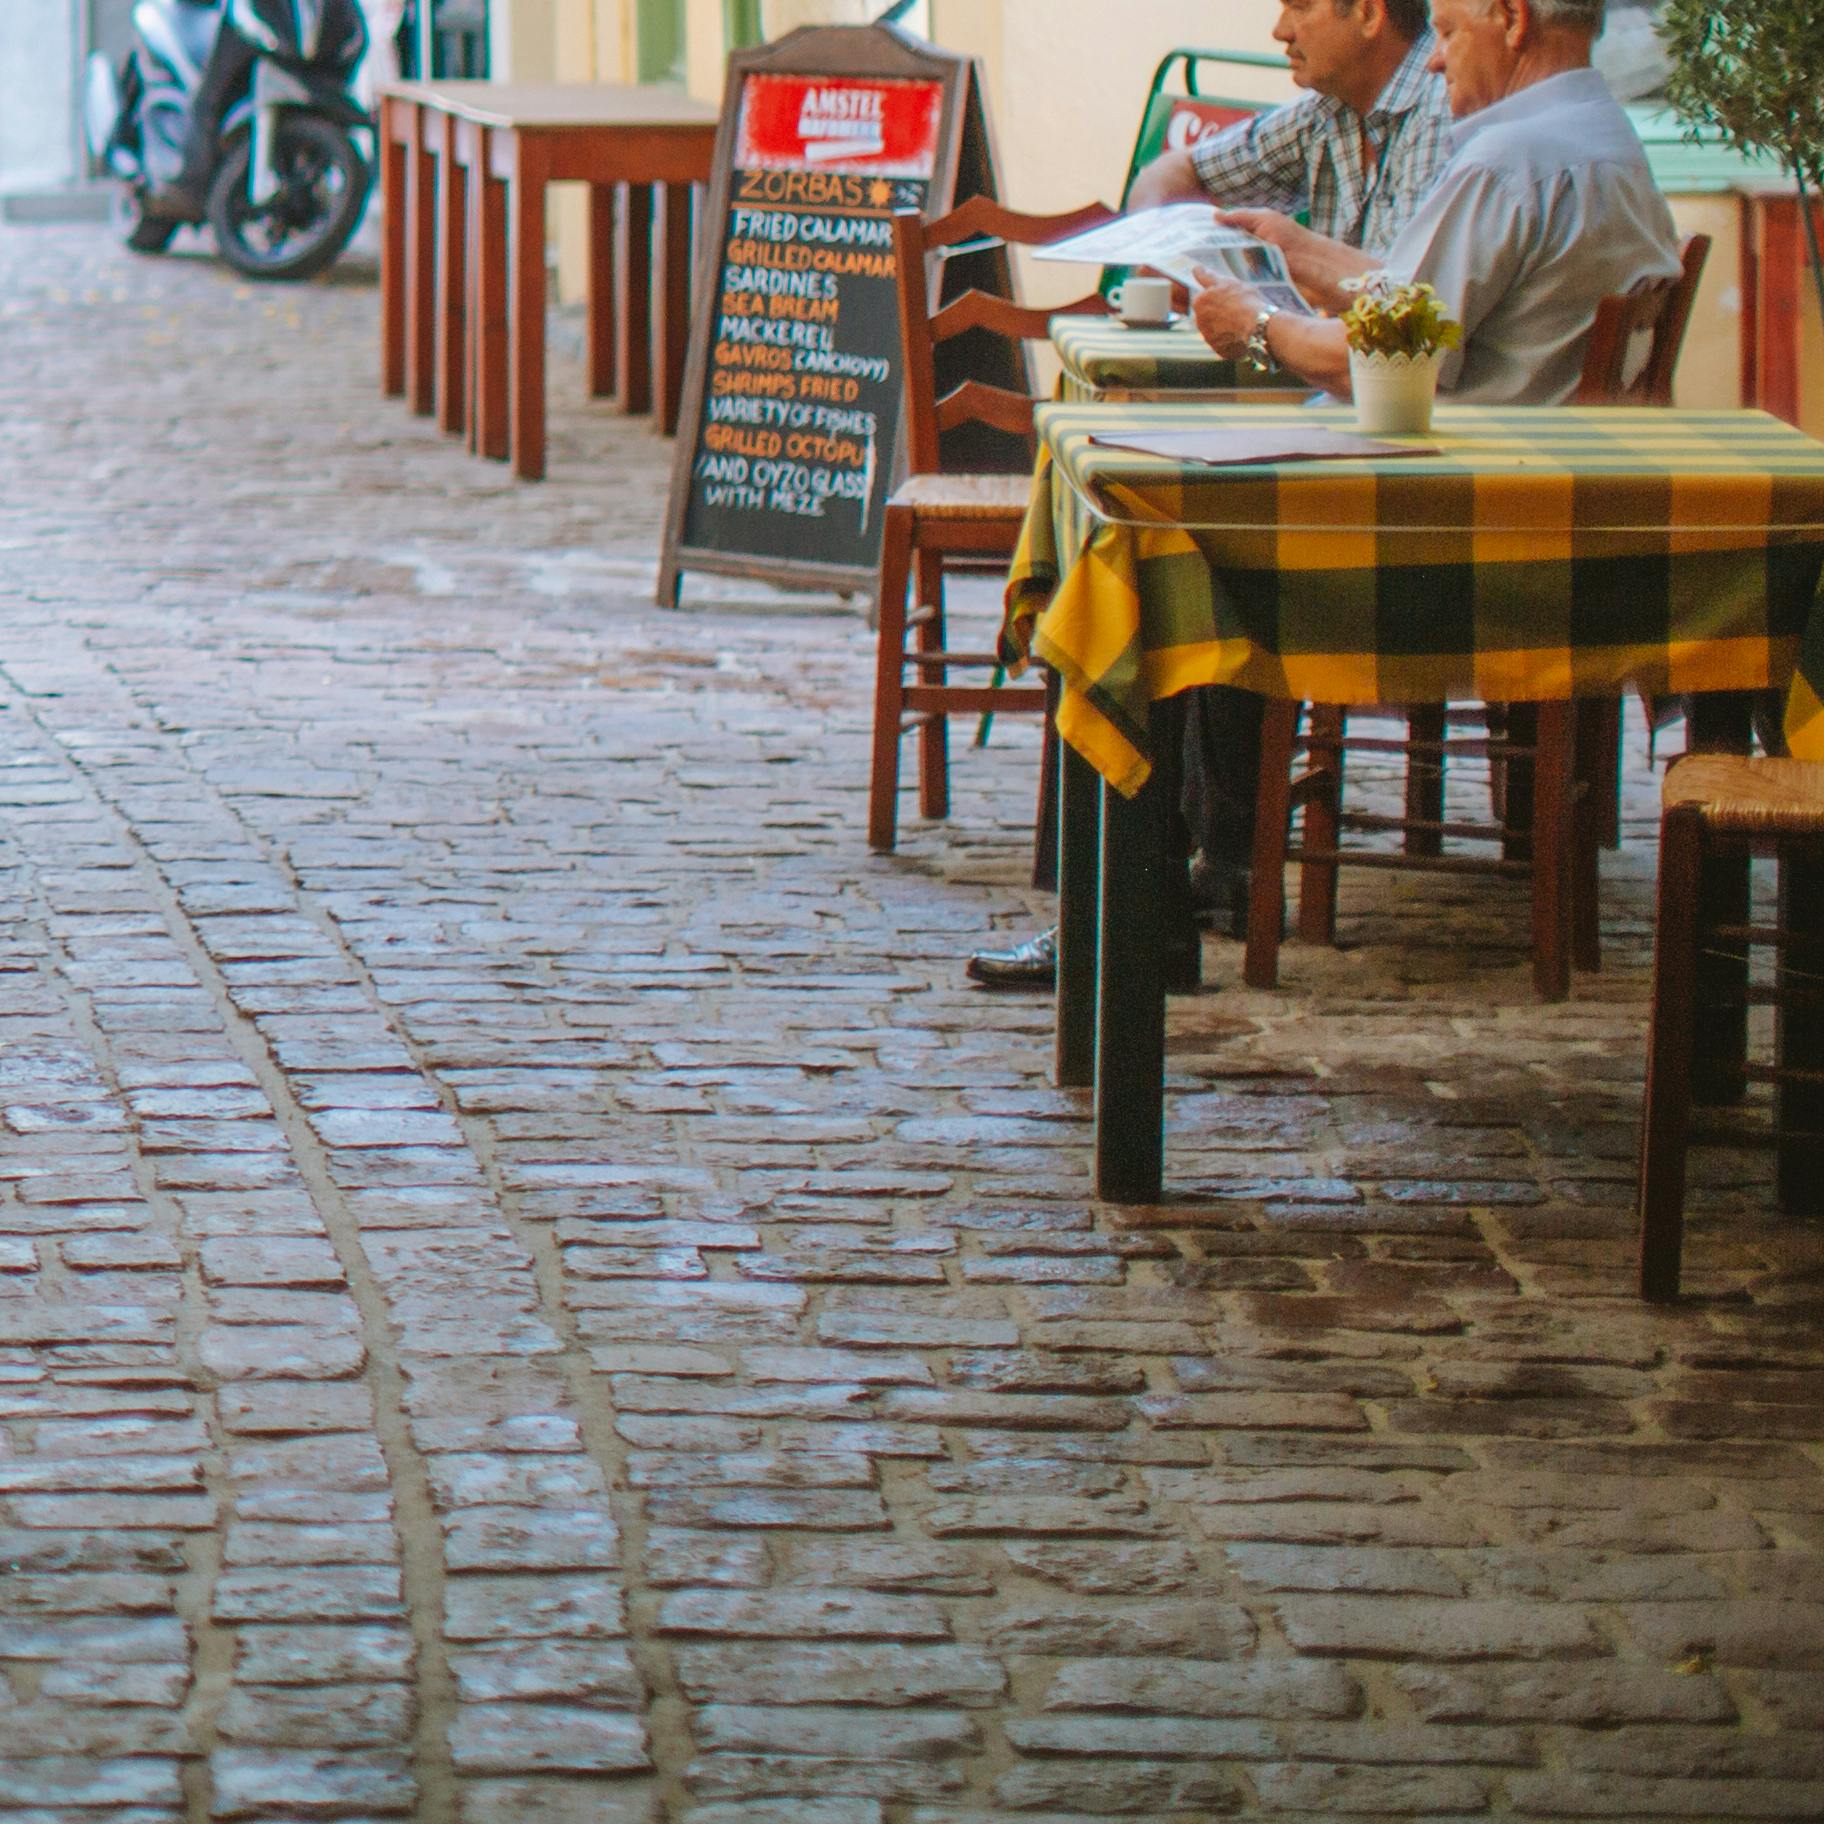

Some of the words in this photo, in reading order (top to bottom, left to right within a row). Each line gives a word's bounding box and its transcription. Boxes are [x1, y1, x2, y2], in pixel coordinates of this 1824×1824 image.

[802, 87, 886, 119] AMSTEL
[739, 170, 863, 207] ZORBAS
[733, 208, 798, 243] FRIED
[728, 238, 812, 271] GRILLED
[724, 265, 839, 300] SARDINES
[722, 291, 765, 317] SEA
[769, 295, 841, 323] BREAM
[714, 341, 793, 371] GAVROS
[712, 370, 796, 399] SHRIMPS
[800, 375, 859, 403] FRIED
[708, 397, 790, 427] VARIETY
[790, 403, 814, 426] OF
[814, 406, 877, 435] FISHES
[705, 423, 782, 458] GRILLED
[786, 433, 877, 466] OCTOPU
[705, 485, 765, 509] WITH
